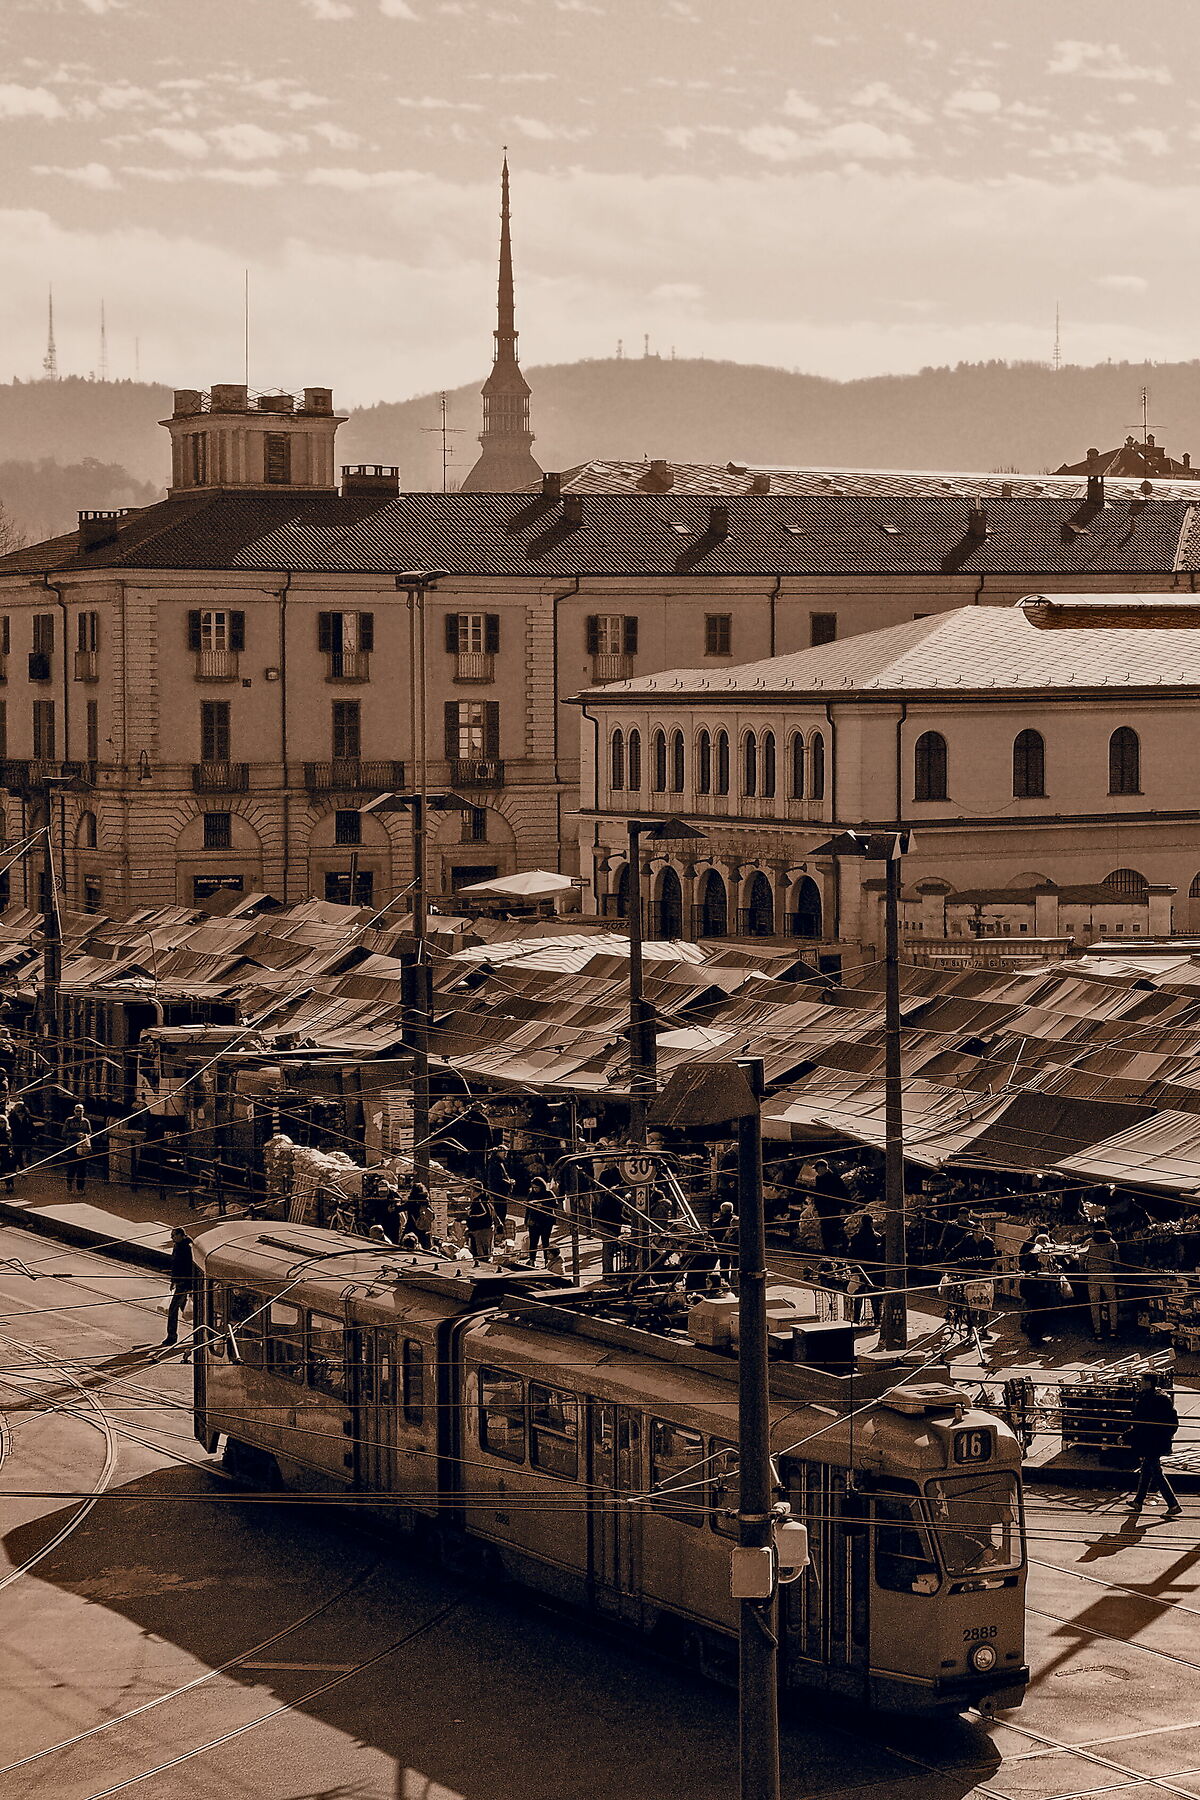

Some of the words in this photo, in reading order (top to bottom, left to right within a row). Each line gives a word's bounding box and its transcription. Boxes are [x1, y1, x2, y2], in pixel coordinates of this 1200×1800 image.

[629, 1156, 649, 1175] 30
[961, 1432, 981, 1458] 16
[962, 1625, 998, 1641] 2888
